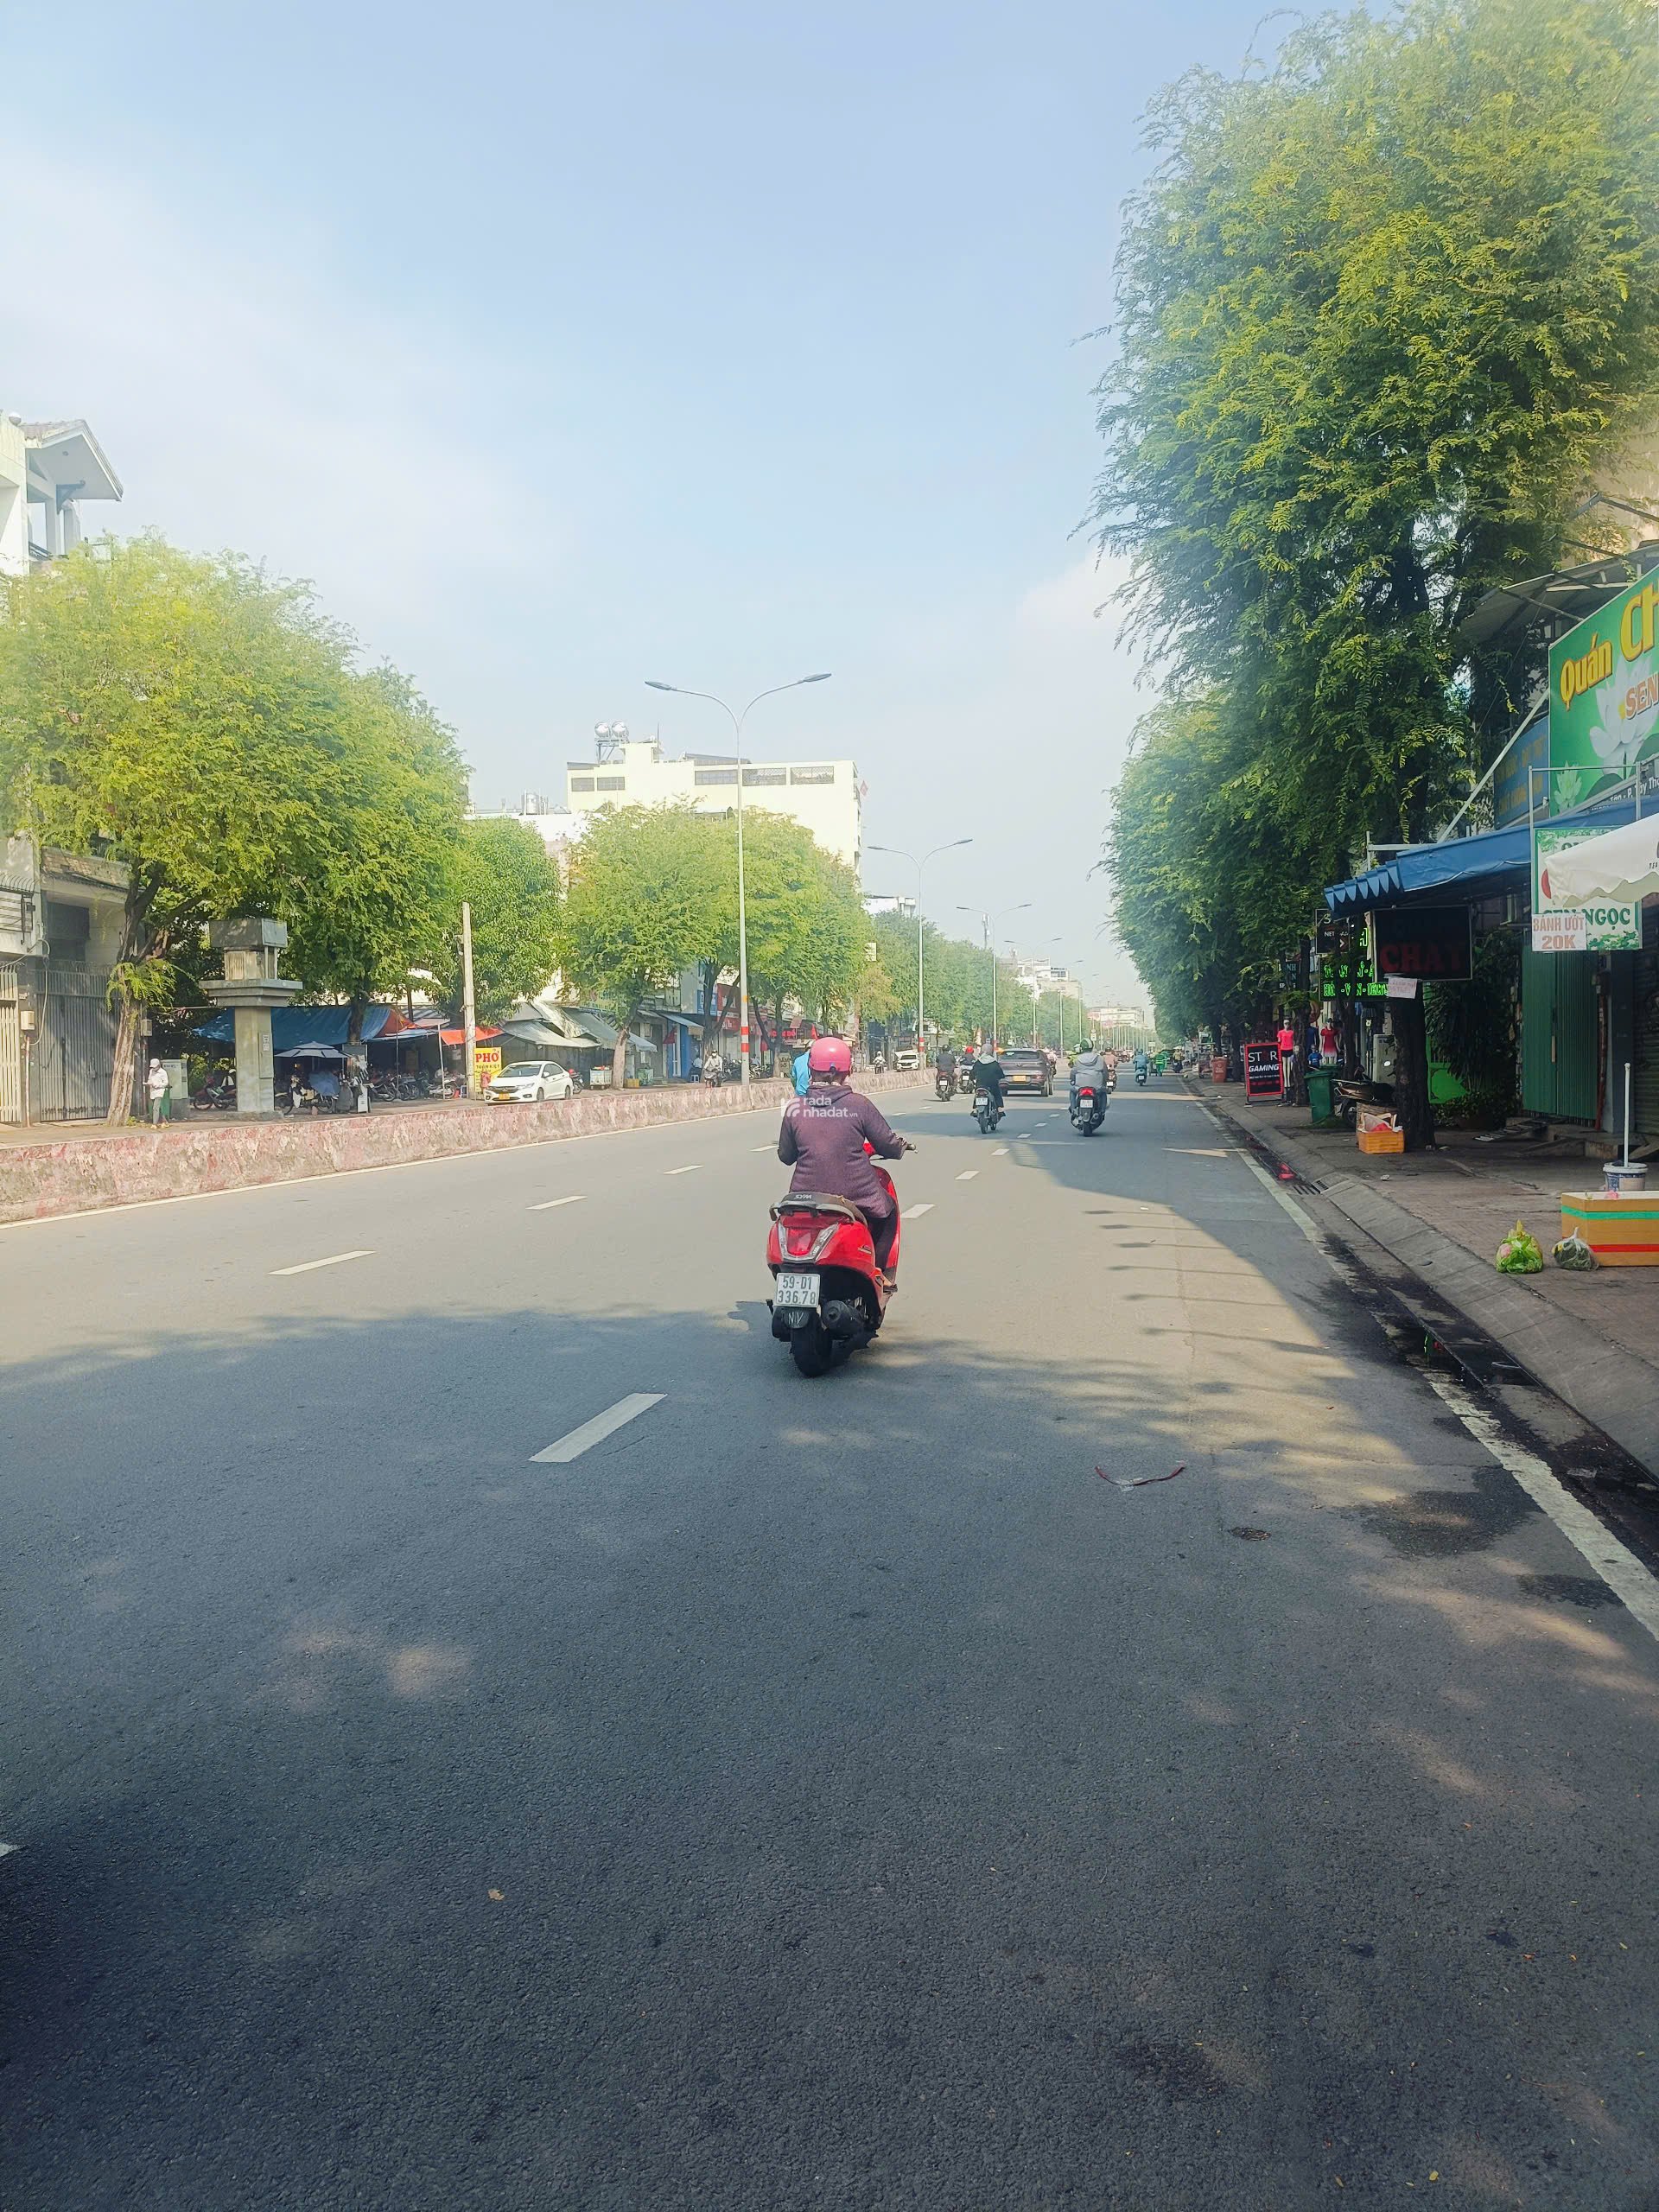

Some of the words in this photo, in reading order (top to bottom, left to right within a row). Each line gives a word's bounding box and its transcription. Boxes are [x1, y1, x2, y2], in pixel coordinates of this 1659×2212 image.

[1560, 631, 1612, 712] Quán
[1624, 672, 1659, 720] SEN
[1533, 914, 1562, 931] BÁNH
[1581, 907, 1630, 931] NGỌC
[1541, 934, 1576, 950] 20K
[475, 1048, 499, 1063] PHỞ
[1249, 1064, 1280, 1072] GAMING
[782, 1275, 811, 1290] 59-D1
[778, 1290, 817, 1305] 336.78
